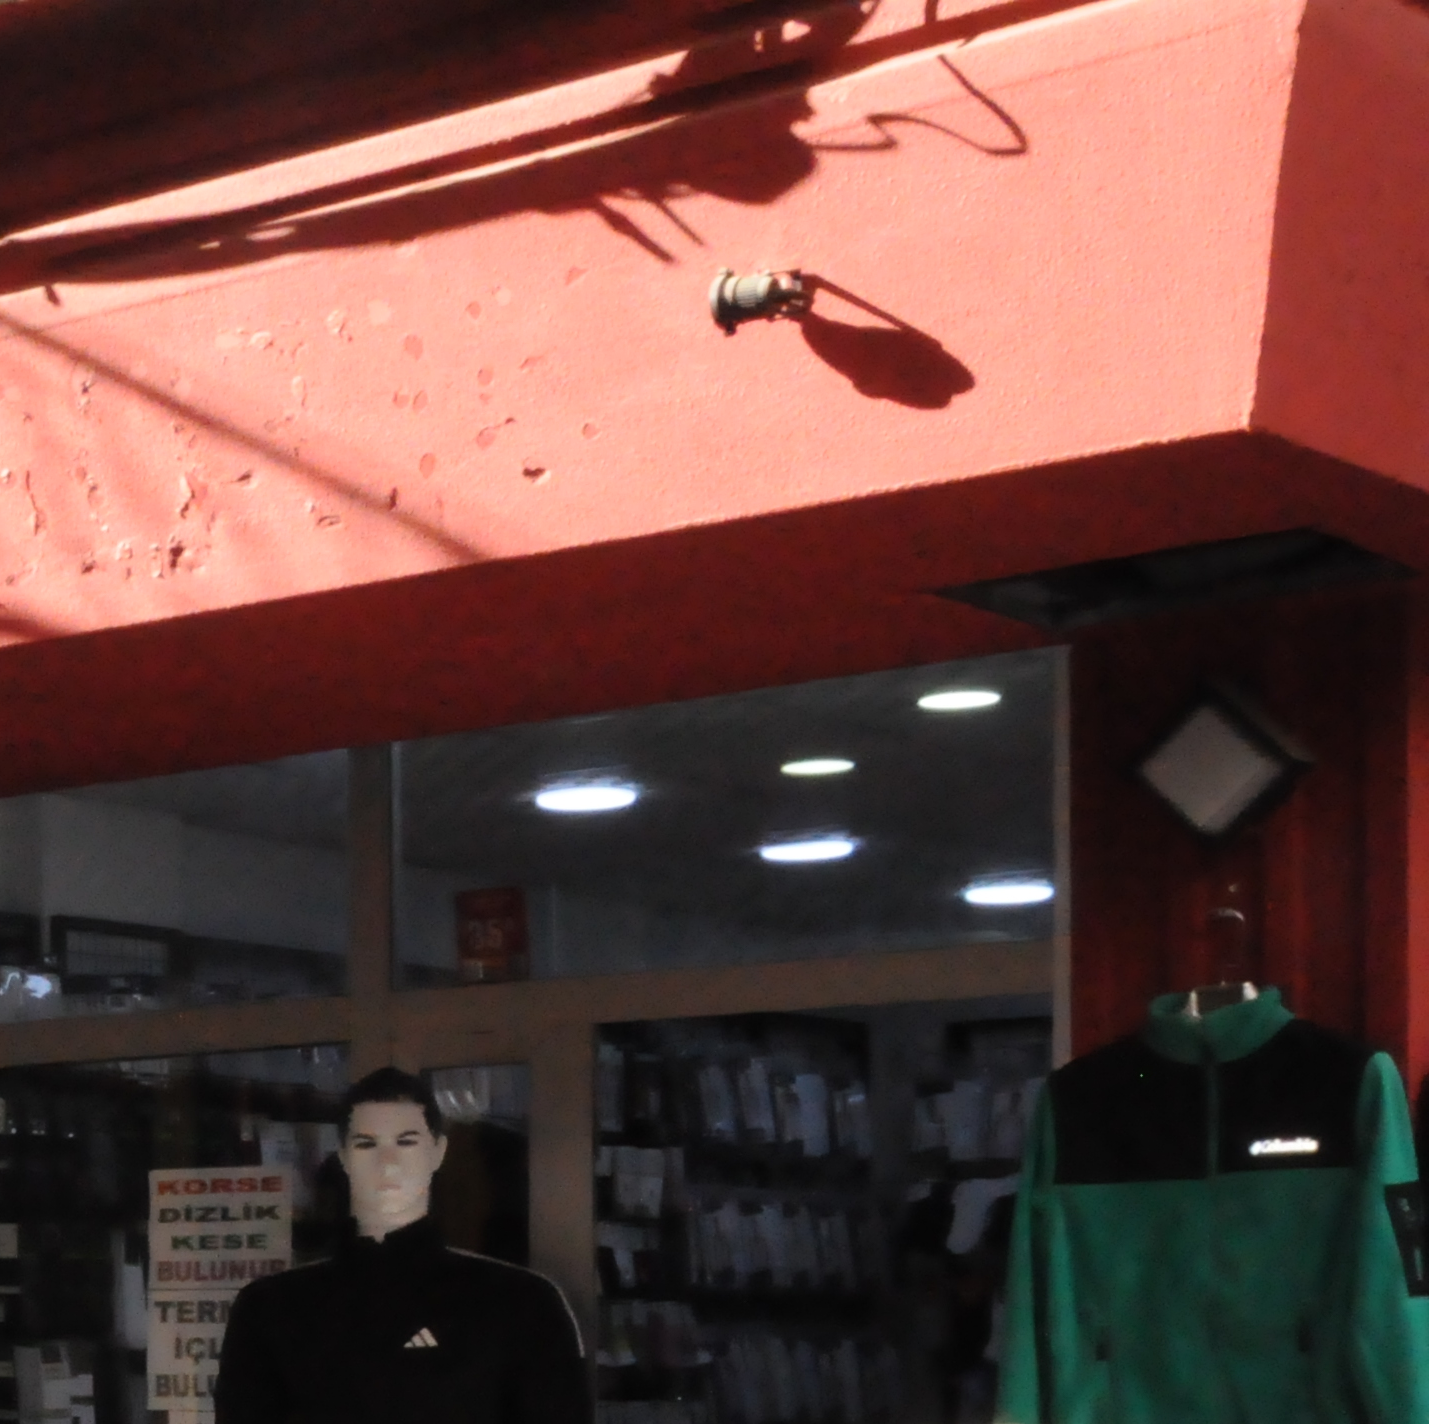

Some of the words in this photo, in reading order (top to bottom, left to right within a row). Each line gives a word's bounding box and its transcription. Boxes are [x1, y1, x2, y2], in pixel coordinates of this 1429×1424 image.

[157, 1176, 283, 1195] KORSE
[158, 1203, 281, 1223] DİZLİK
[171, 1234, 268, 1250] KESE
[157, 1259, 287, 1282] BULUNUR
